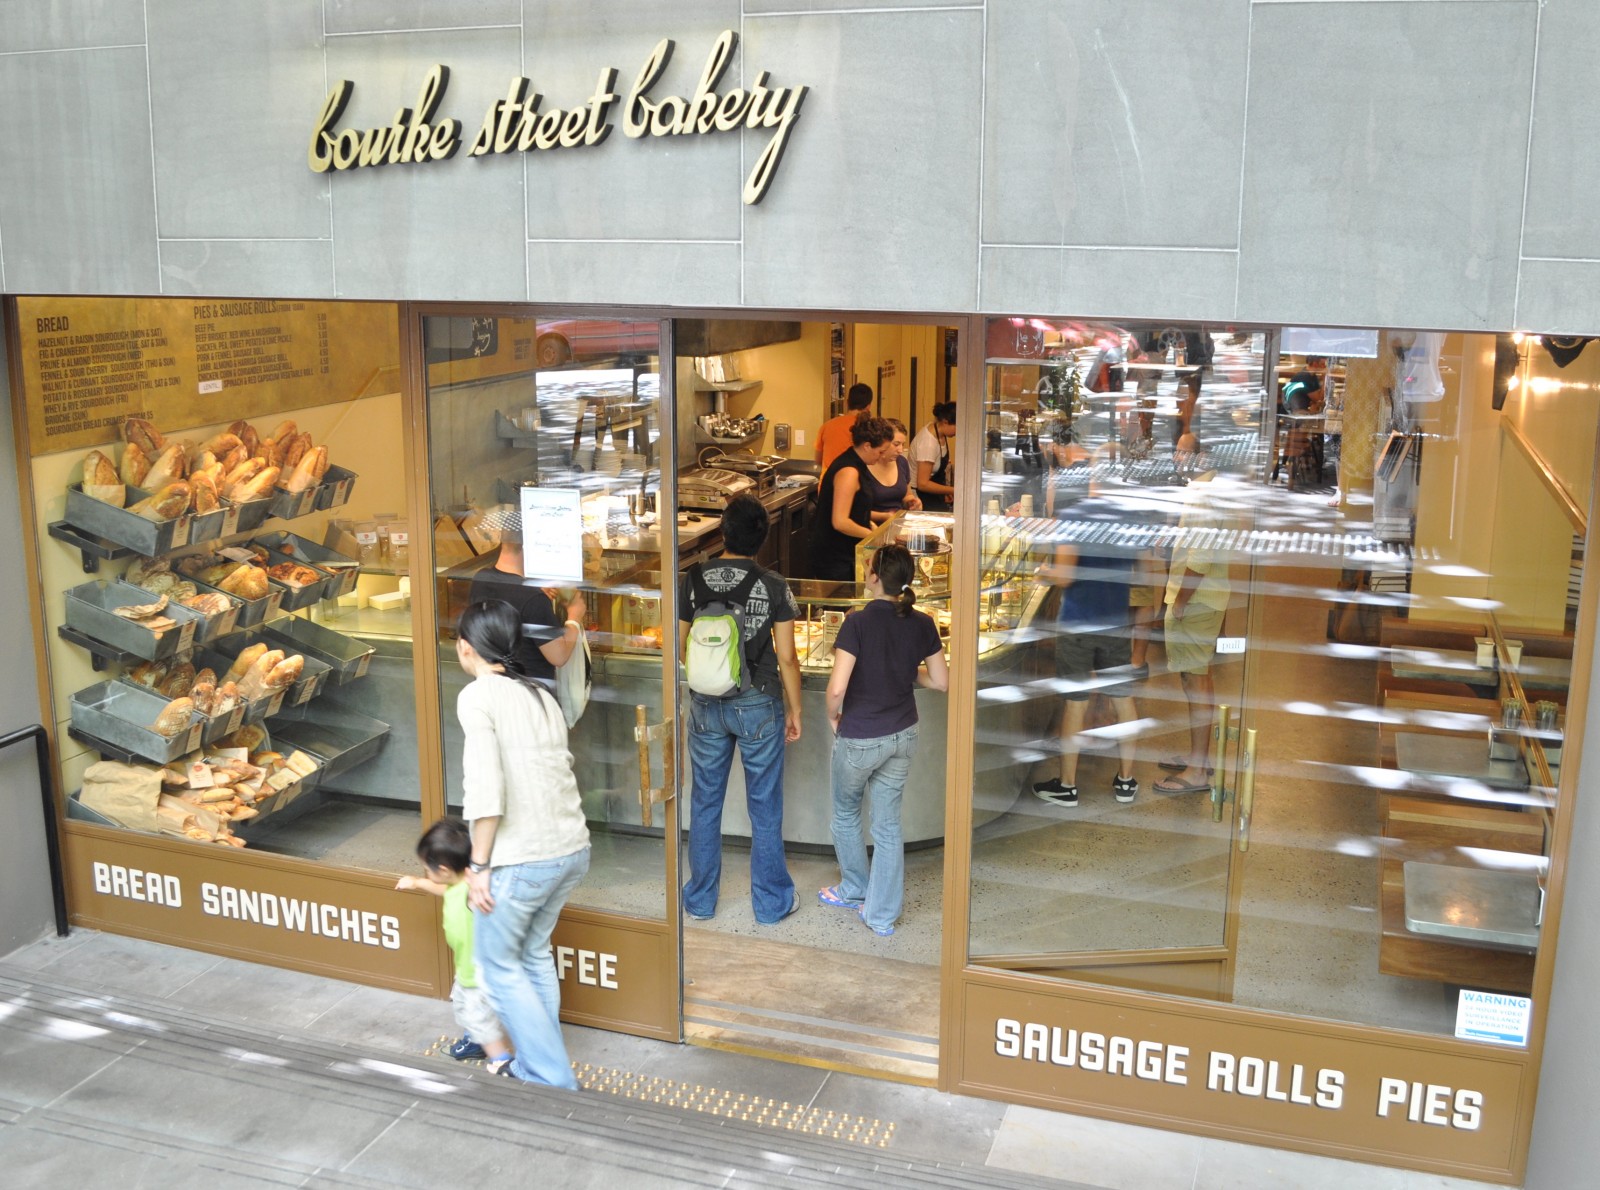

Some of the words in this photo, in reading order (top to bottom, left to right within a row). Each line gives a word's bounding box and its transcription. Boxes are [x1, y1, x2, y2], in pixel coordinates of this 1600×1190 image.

[308, 64, 462, 174] bourke
[467, 67, 621, 158] street
[623, 29, 810, 206] bakery
[194, 305, 211, 319] PIES
[213, 305, 218, 317] &
[220, 303, 252, 317] SAUSAGE
[255, 301, 276, 314] ROLLS
[37, 316, 69, 333] BREAD
[195, 324, 206, 332] BEEF
[38, 337, 68, 347] HAZELNUT
[70, 336, 74, 345] &
[76, 334, 94, 344] RAISIN
[95, 331, 128, 342] SOURDOUGH
[56, 346, 89, 357] CRANBERRY
[91, 342, 124, 354] SOURDOUGH
[40, 360, 60, 370] PRUNE
[67, 356, 90, 367] ALMOND
[92, 353, 126, 364] SOURDOUGH
[41, 370, 62, 380] FENNEL
[70, 367, 85, 377] SOUR
[87, 365, 107, 375] CHERRY
[111, 361, 143, 373] SOURDOUGH
[42, 381, 66, 392] WALNUT
[74, 377, 99, 388] CURRANT
[101, 373, 134, 385] SOURDOUGH
[43, 392, 66, 402] POTATO
[73, 387, 102, 399] ROSEMARY
[105, 382, 138, 394] SOURDOUGH
[44, 404, 61, 414] WHEY
[68, 401, 79, 411] RYE
[80, 396, 114, 409] SOURDOUGH
[45, 414, 71, 425] BRIOCHE
[46, 422, 82, 436] SOURDOUGH
[84, 419, 101, 430] BREAD
[92, 861, 182, 909] BREAD
[200, 881, 401, 952] SANDWICHES
[1464, 992, 1526, 1008] WARNING
[1476, 1020, 1519, 1030] OPERATION
[994, 1018, 1190, 1086] SAUSAGE
[1206, 1050, 1346, 1110] ROLLS
[1376, 1076, 1484, 1131] PIES
